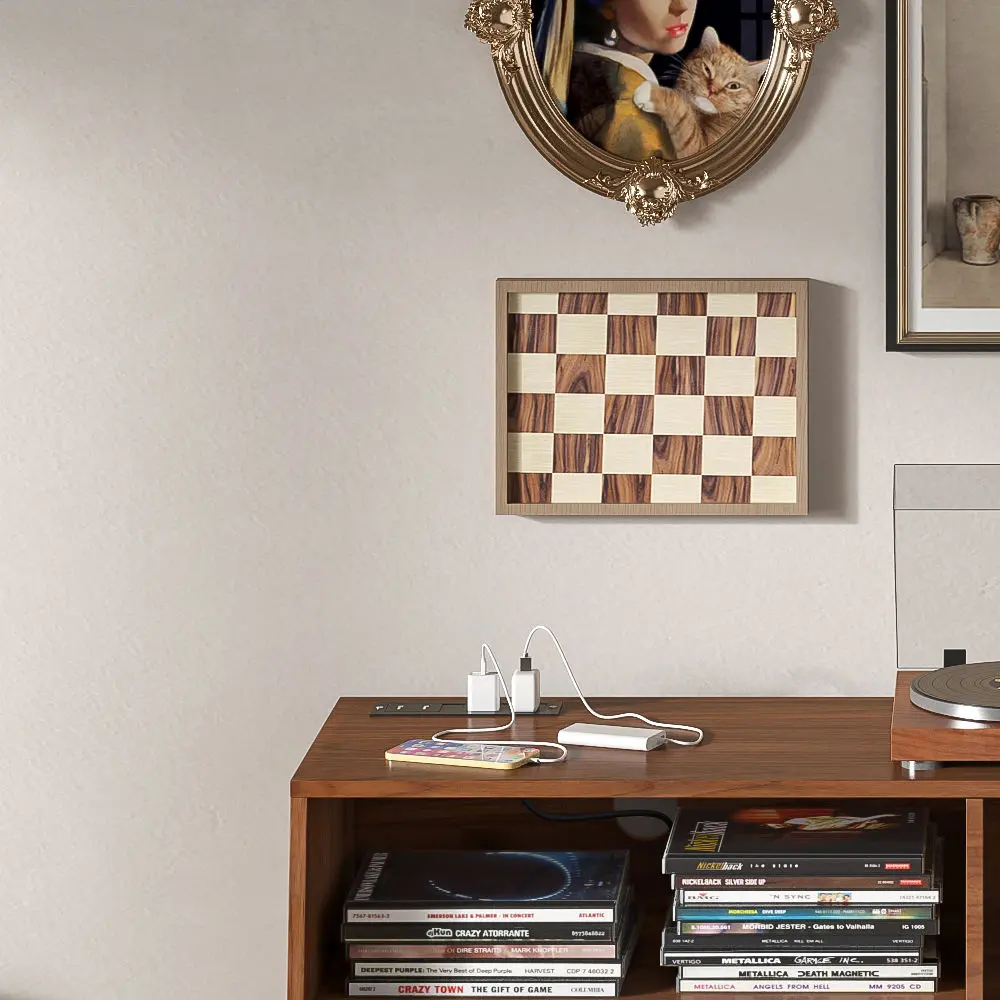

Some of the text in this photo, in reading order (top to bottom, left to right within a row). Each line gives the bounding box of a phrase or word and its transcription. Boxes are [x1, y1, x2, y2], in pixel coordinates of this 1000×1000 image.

[455, 930, 529, 938] CRAZY ATORRANTE
[398, 986, 552, 994] CRAZY TOWN THE GIFT OF GAME
